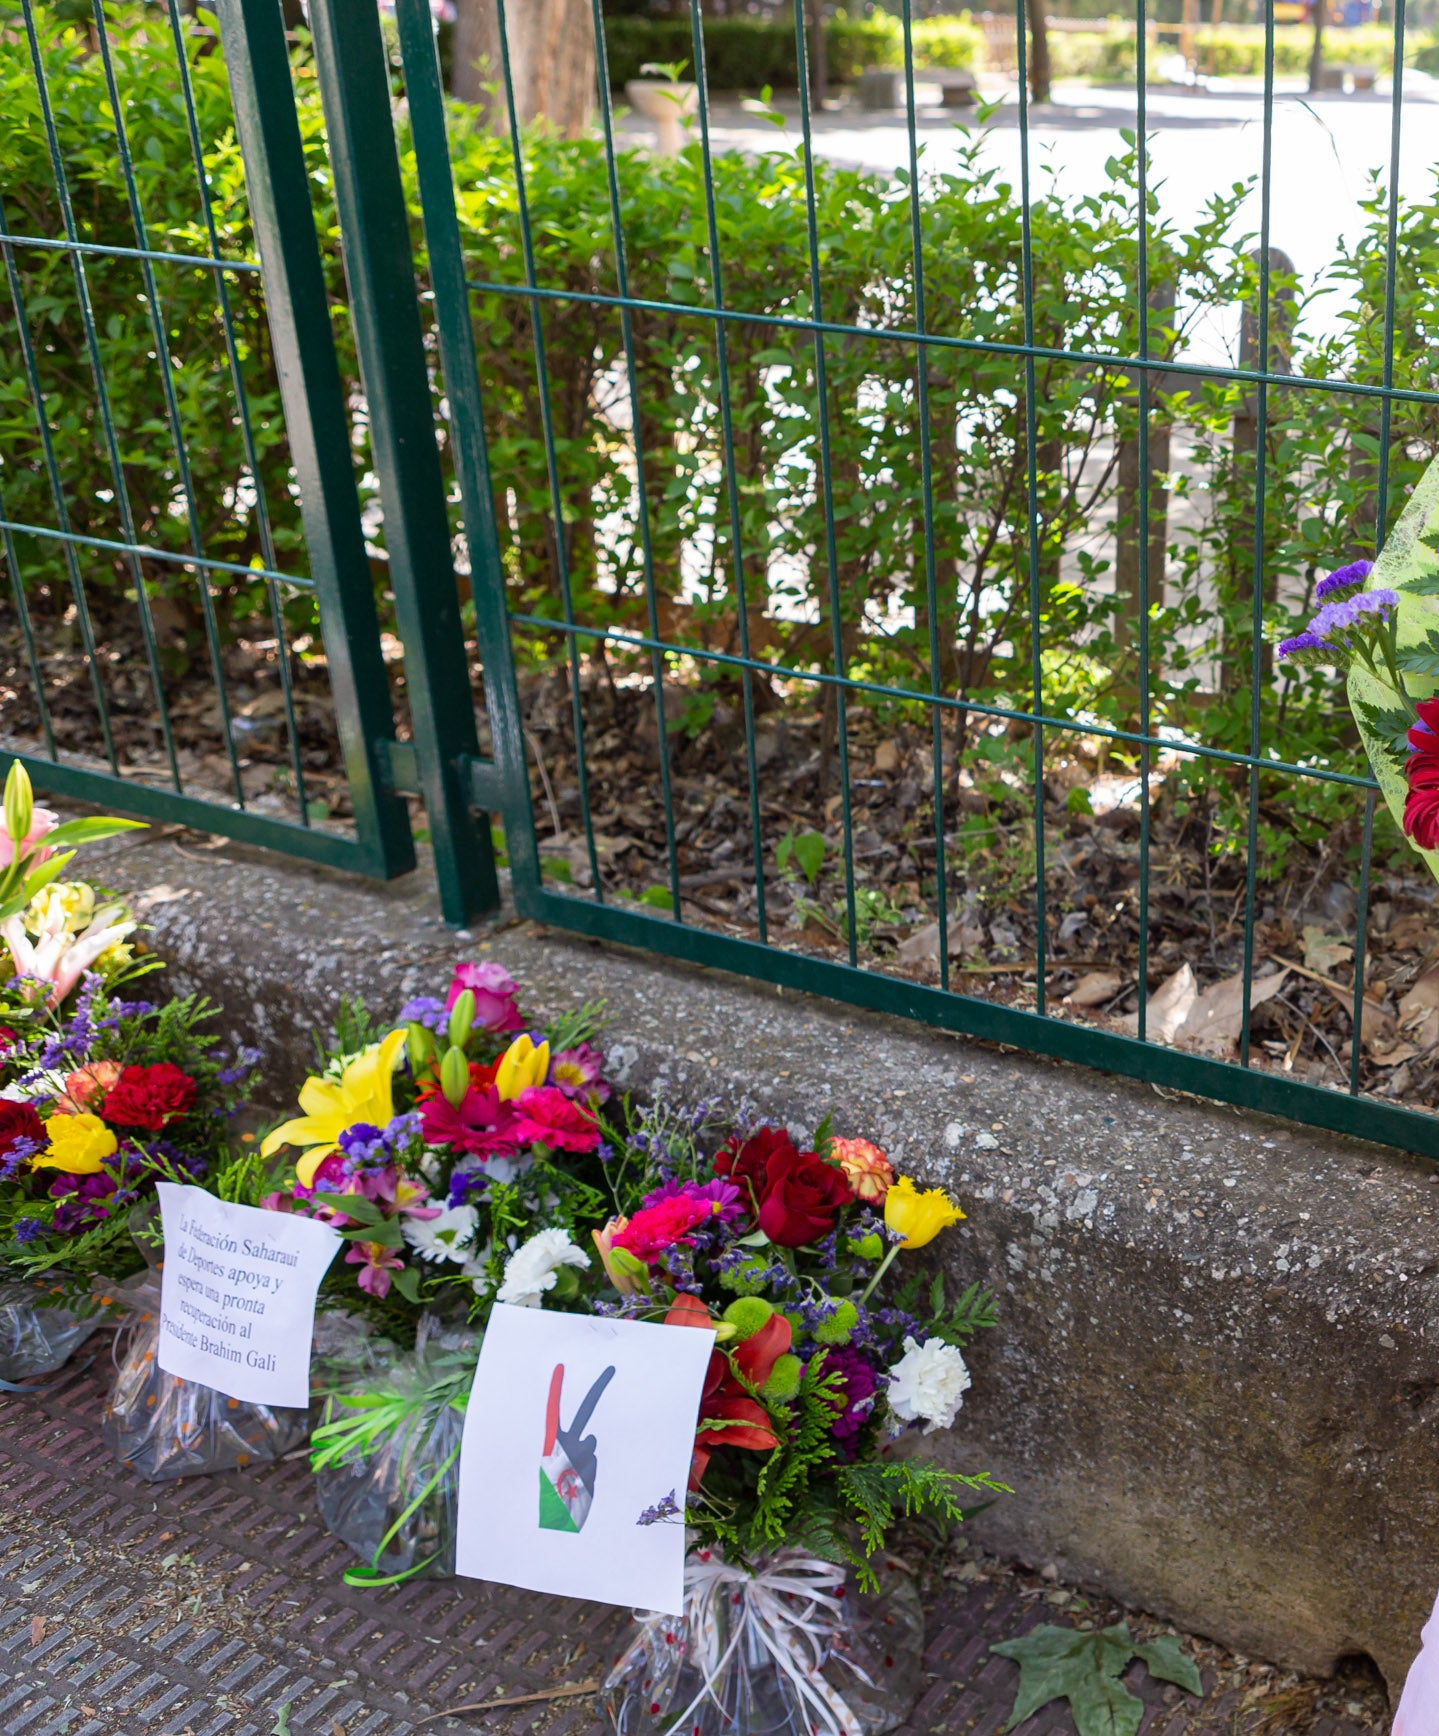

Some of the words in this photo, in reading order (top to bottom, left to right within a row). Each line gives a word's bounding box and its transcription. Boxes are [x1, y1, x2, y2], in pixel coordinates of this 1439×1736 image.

[180, 1213, 188, 1233] La
[189, 1219, 238, 1253] Federación
[241, 1239, 300, 1267] Saharaui
[178, 1242, 187, 1260] de
[188, 1246, 225, 1278] Deportes
[228, 1268, 271, 1290] apoya
[271, 1278, 284, 1294] y
[178, 1273, 204, 1295] espera
[205, 1285, 220, 1304] una
[221, 1294, 266, 1315] pronta
[180, 1300, 236, 1336] recuperación
[239, 1322, 253, 1340] al
[200, 1334, 242, 1363] Brahim
[246, 1350, 277, 1372] Gali
